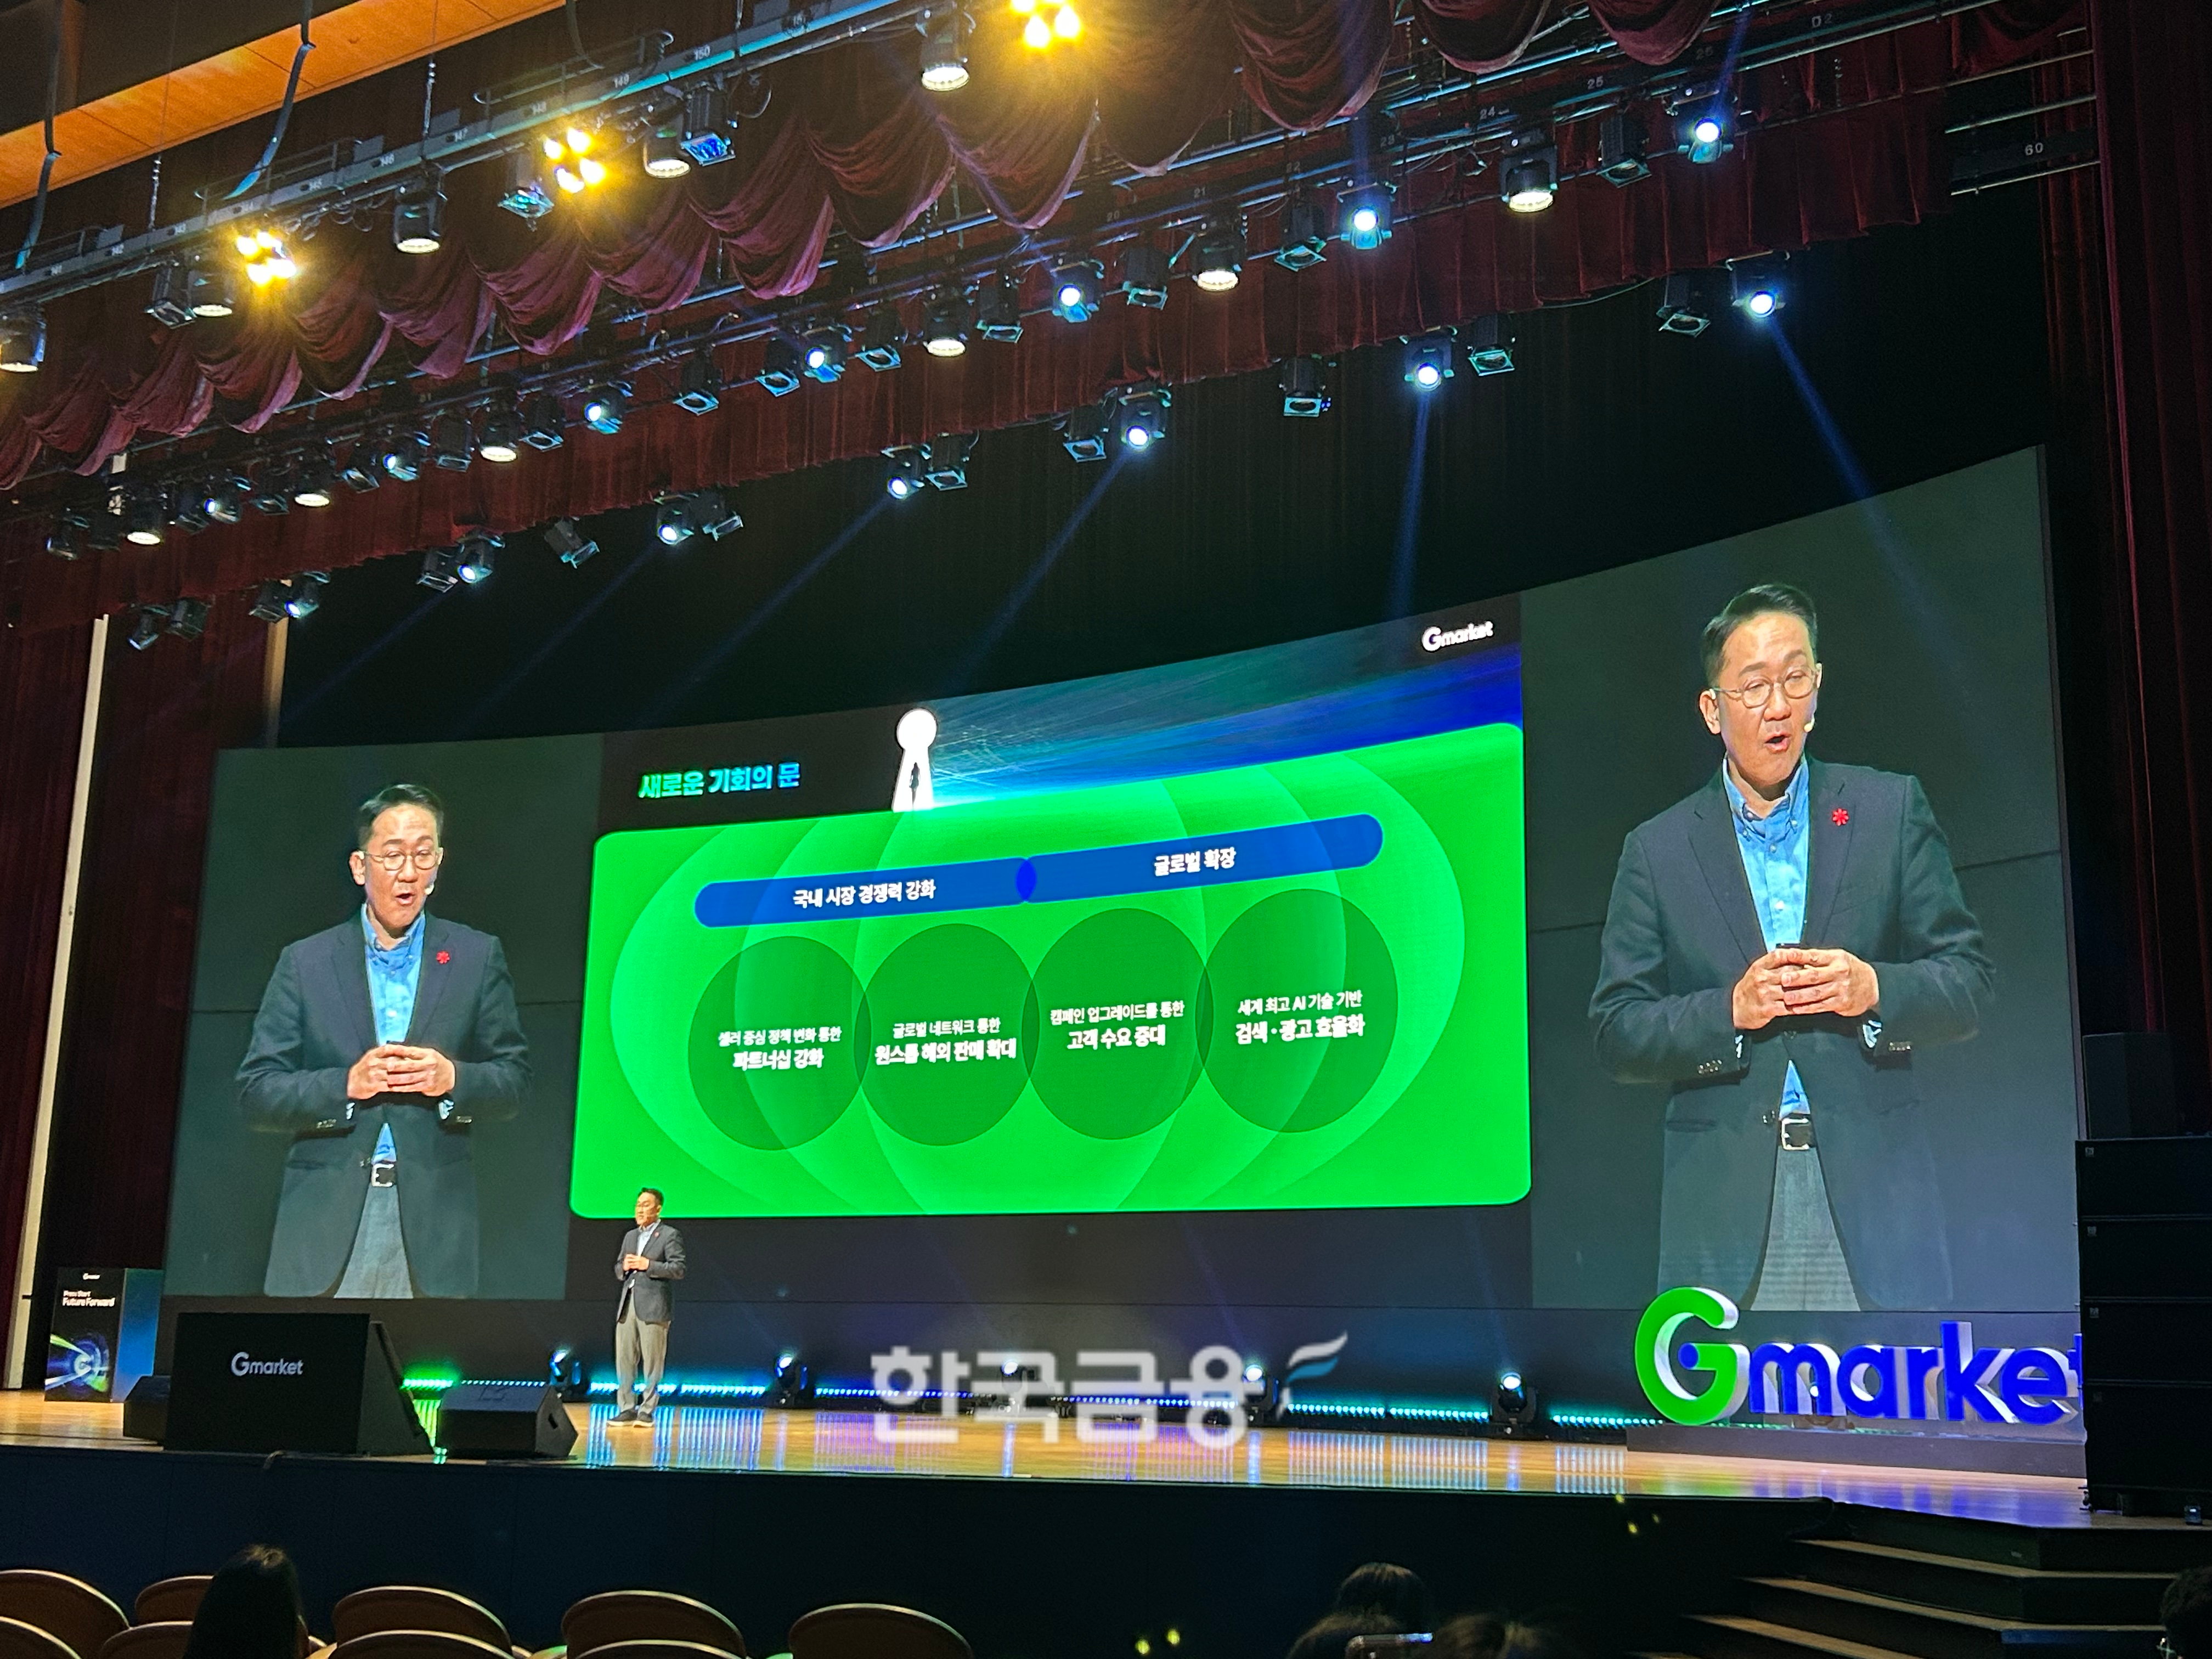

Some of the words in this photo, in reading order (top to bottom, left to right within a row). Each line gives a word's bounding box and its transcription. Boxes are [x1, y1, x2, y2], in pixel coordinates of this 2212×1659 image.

[695, 44, 710, 60] 150
[1480, 106, 1495, 120] 24
[2025, 143, 2044, 156] 60
[1422, 621, 1493, 651] Gmarket
[638, 769, 704, 798] 새로운
[708, 765, 773, 793] 기회의
[777, 762, 800, 787] 문
[1154, 851, 1200, 877] 글로벌
[1204, 847, 1237, 870] 확장
[793, 888, 823, 909] 국내
[826, 885, 856, 906] 시장
[859, 882, 902, 904] 경쟁력
[906, 879, 936, 900] 강화
[1050, 1007, 1085, 1025] 캠페인
[1087, 1002, 1158, 1023] 업그레이드를
[1160, 1000, 1185, 1018] 통한
[1238, 998, 1263, 1016] 세계
[1265, 997, 1290, 1014] 최고
[1292, 996, 1306, 1011] AI
[1308, 992, 1334, 1011] 기술
[1336, 989, 1363, 1008] 기반
[743, 1029, 766, 1046] 중심
[768, 1028, 791, 1045] 정책
[793, 1028, 817, 1043] 변화
[819, 1026, 842, 1042] 통한
[893, 1022, 927, 1039] 글로벌
[929, 1019, 975, 1036] 네트워크
[977, 1017, 1001, 1034] 통한
[1067, 1028, 1098, 1050] 고객
[1101, 1028, 1132, 1049] 수요
[1134, 1024, 1166, 1047] 증대
[1314, 1013, 1365, 1038] 효율화
[732, 1049, 791, 1071] 파트너십
[794, 1047, 824, 1069] 강화
[921, 1041, 951, 1063] 해외
[953, 1040, 984, 1062] 판매
[987, 1037, 1017, 1060] 확대
[231, 1351, 304, 1376] Gmarket
